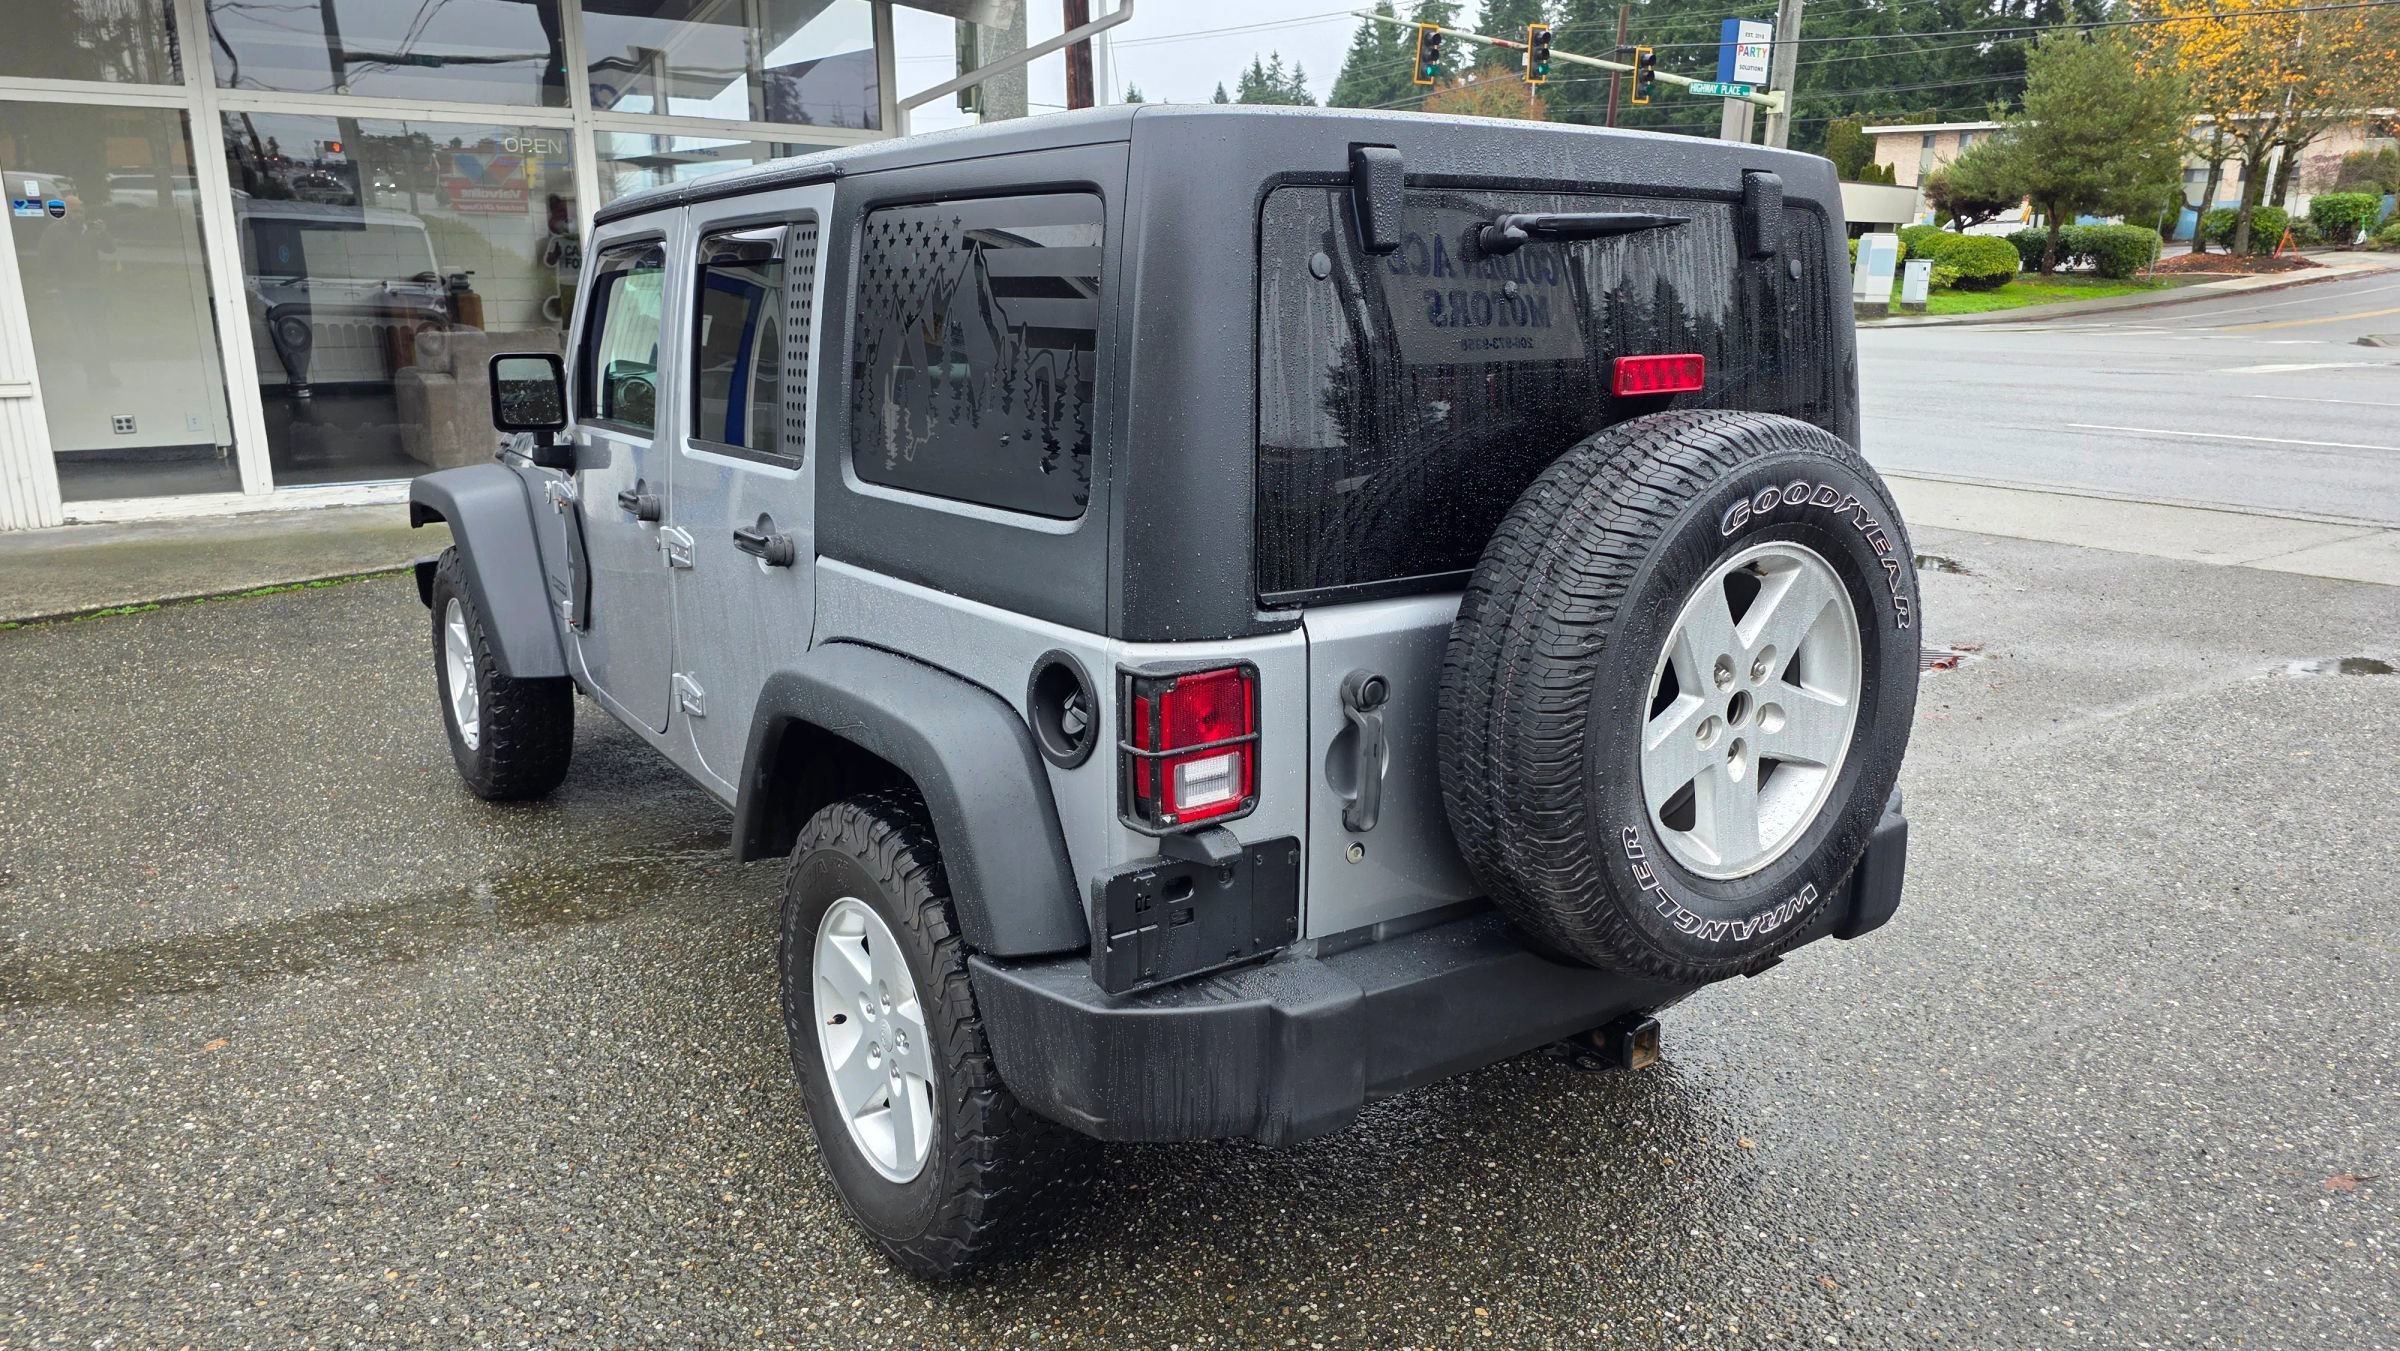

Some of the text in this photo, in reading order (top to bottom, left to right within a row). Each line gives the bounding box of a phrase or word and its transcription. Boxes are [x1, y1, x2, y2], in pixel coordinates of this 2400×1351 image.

[1738, 44, 1768, 58] PARTY
[1739, 64, 1764, 72] SOLUTIONS
[1690, 83, 1718, 93] HIGHWAY
[1720, 85, 1741, 95] PLACE
[504, 137, 562, 154] OPEN
[565, 246, 580, 256] CA
[565, 258, 582, 268] FO
[1721, 481, 1912, 629] GOODYEAR
[1622, 825, 1819, 942] WRANGLER
